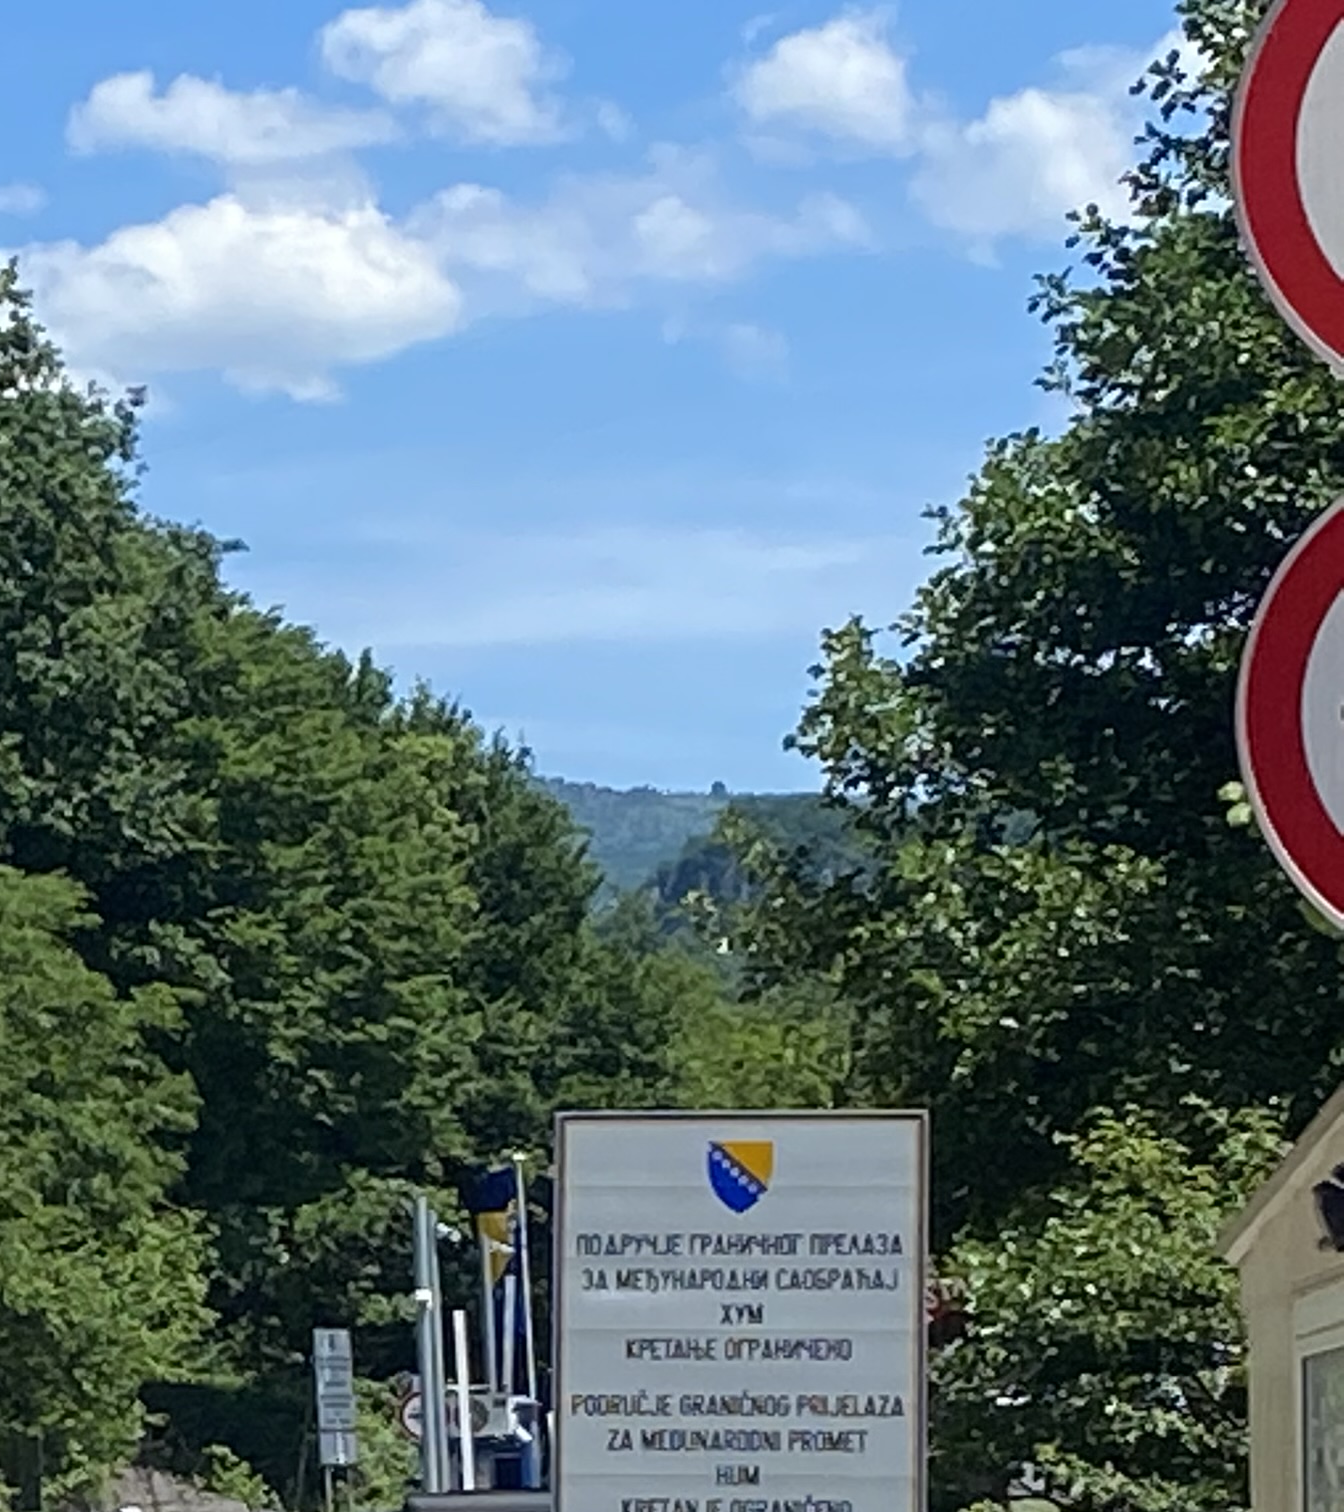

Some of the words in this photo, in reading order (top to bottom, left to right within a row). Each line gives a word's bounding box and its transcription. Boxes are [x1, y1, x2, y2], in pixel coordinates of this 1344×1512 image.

[576, 1233, 683, 1255] ПОДРУЧЈЕ
[690, 1232, 802, 1255] ГРАНИЧНОГ
[810, 1233, 903, 1255] ПРЕЛАЗА
[582, 1268, 608, 1290] ЗА
[616, 1268, 768, 1292] МЕЂУНАРОДНИ
[776, 1268, 899, 1291] САОБРАЋАЈ
[720, 1304, 764, 1324] ХУМ
[626, 1338, 717, 1360] КРЕТАЊЕ
[725, 1338, 853, 1361] ОГРАНИЧЕНО
[571, 1389, 672, 1416] PODRUČJE
[680, 1389, 790, 1416] GRANIČNOG
[796, 1395, 905, 1416] PRIJELAZA
[607, 1429, 633, 1451] ZA
[788, 1430, 868, 1452] PROMET
[716, 1465, 760, 1486] HUM
